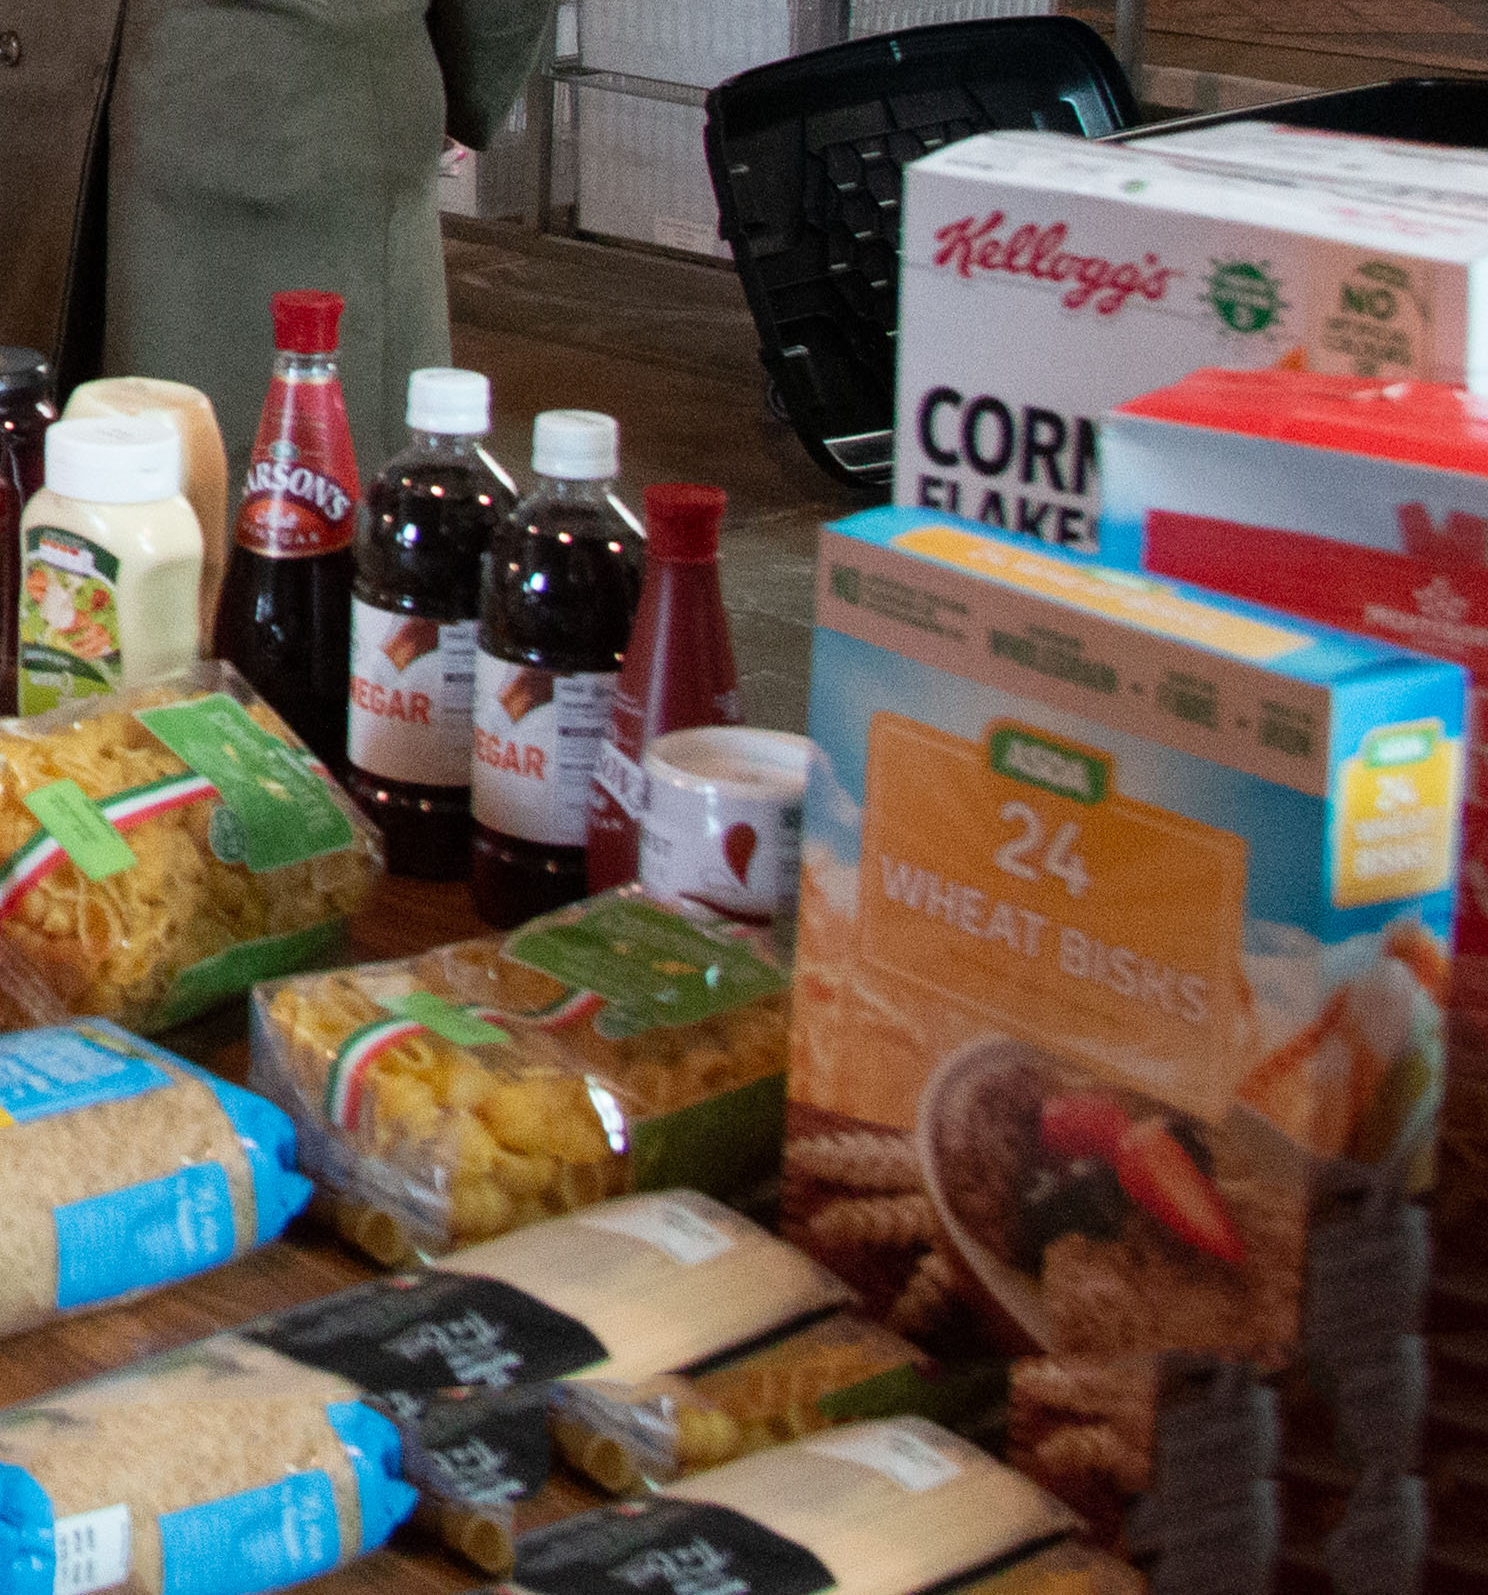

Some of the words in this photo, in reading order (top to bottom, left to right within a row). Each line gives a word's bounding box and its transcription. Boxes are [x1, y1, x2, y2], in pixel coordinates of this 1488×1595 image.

[932, 210, 1187, 317] Kellogg's
[916, 474, 1100, 553] FLAKE
[994, 800, 1094, 897] 24
[880, 855, 1047, 959] WHEAT
